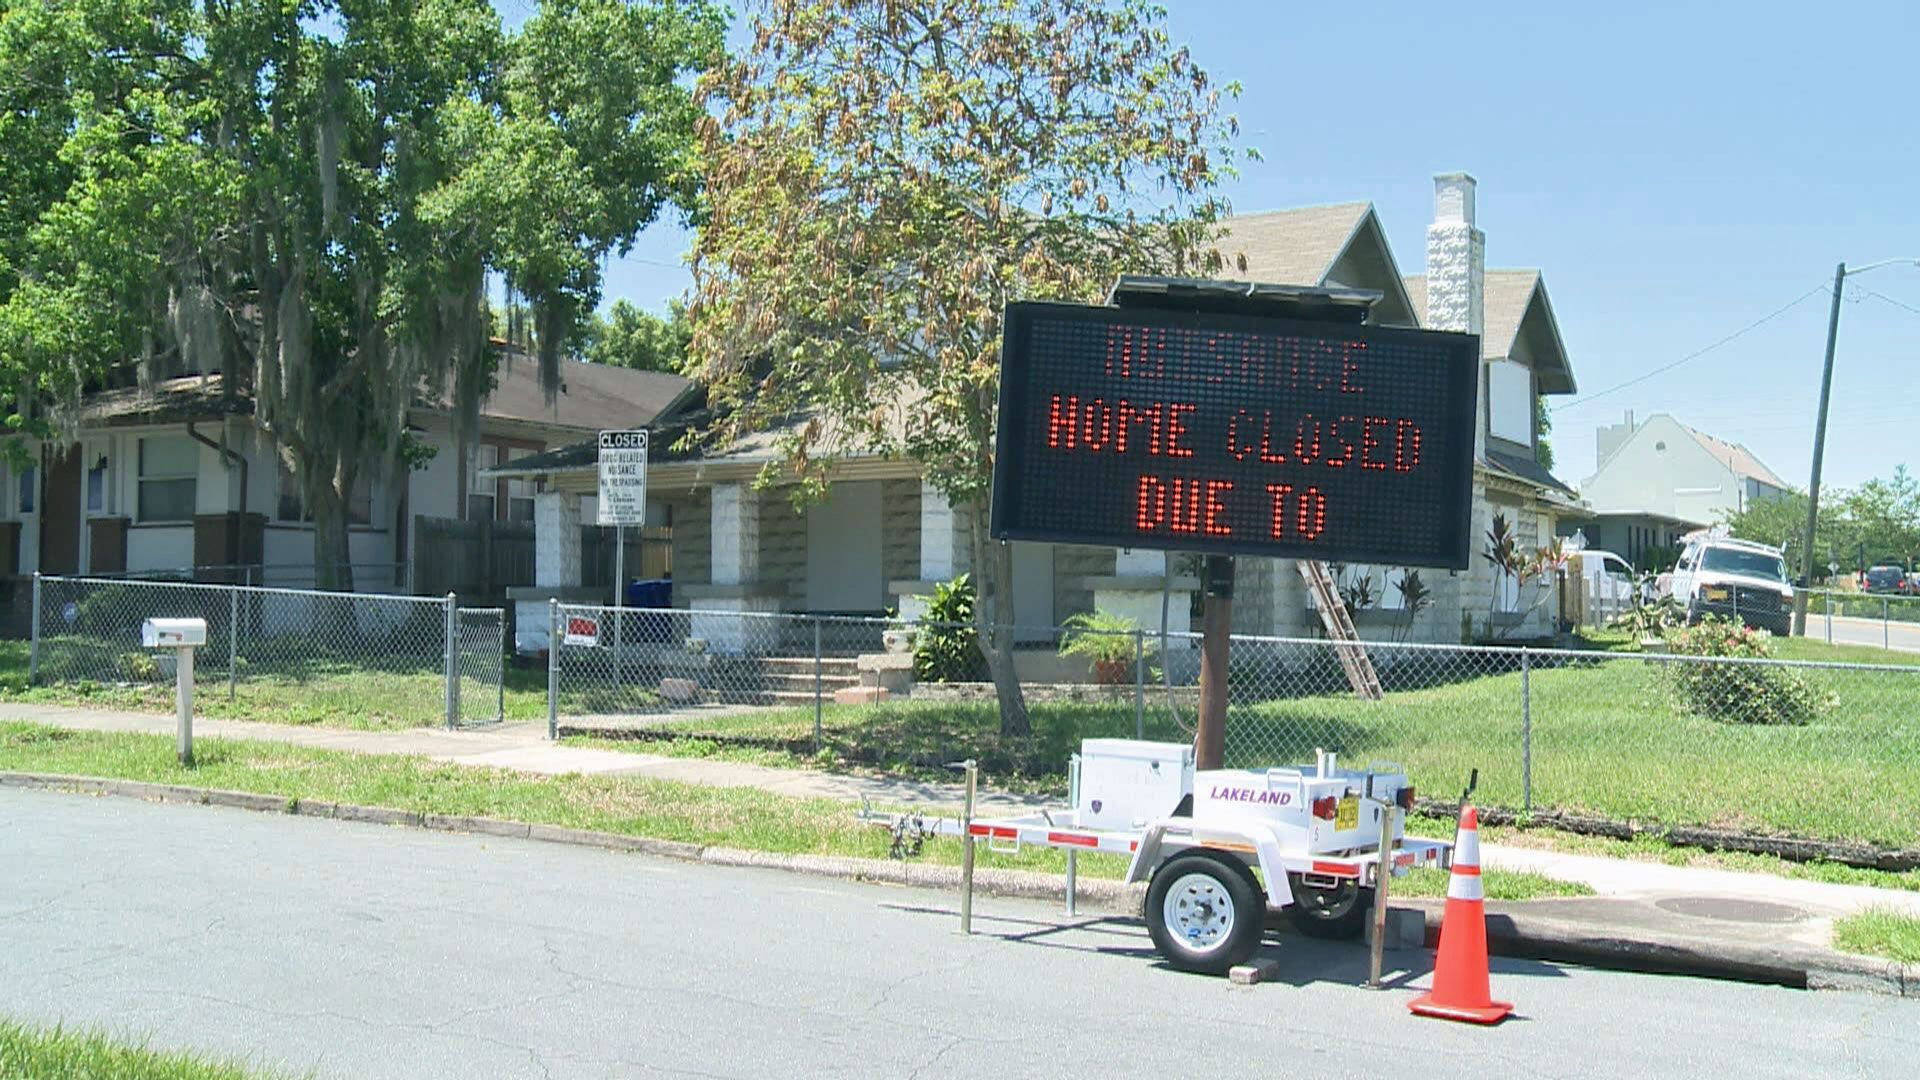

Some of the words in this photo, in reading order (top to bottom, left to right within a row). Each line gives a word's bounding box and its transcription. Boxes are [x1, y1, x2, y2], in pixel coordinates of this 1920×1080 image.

[601, 434, 645, 447] CLOSED
[1048, 393, 1198, 458] HOME
[1226, 407, 1422, 473] CLOSED
[1136, 474, 1235, 536] DUE
[1265, 483, 1327, 541] TO
[1210, 786, 1292, 806] LAKELAND
